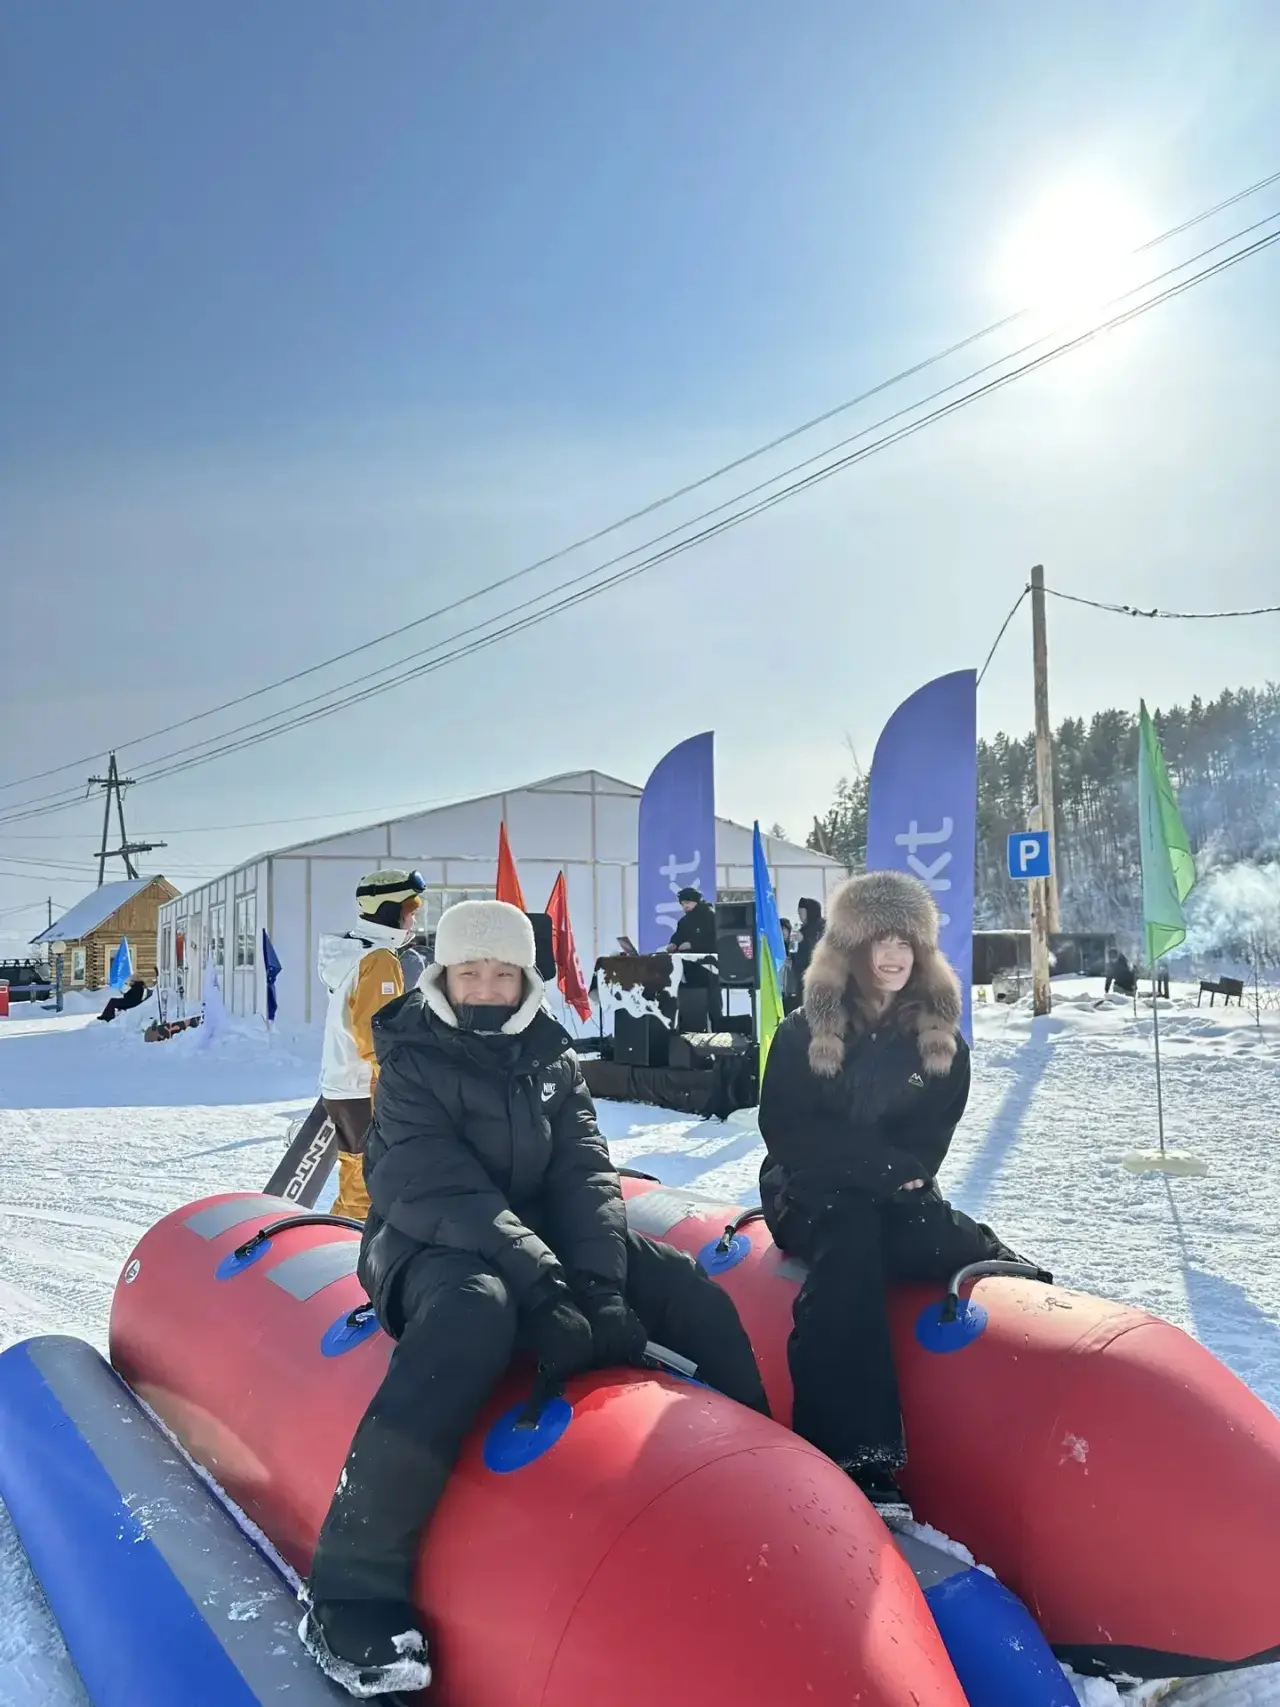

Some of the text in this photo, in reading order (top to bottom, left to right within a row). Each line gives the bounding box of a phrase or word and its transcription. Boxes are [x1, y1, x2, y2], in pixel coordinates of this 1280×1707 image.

[895, 817, 954, 928] kt
[1019, 839, 1041, 872] P
[543, 1082, 557, 1093] NIKE
[281, 1117, 336, 1202] ENTO
